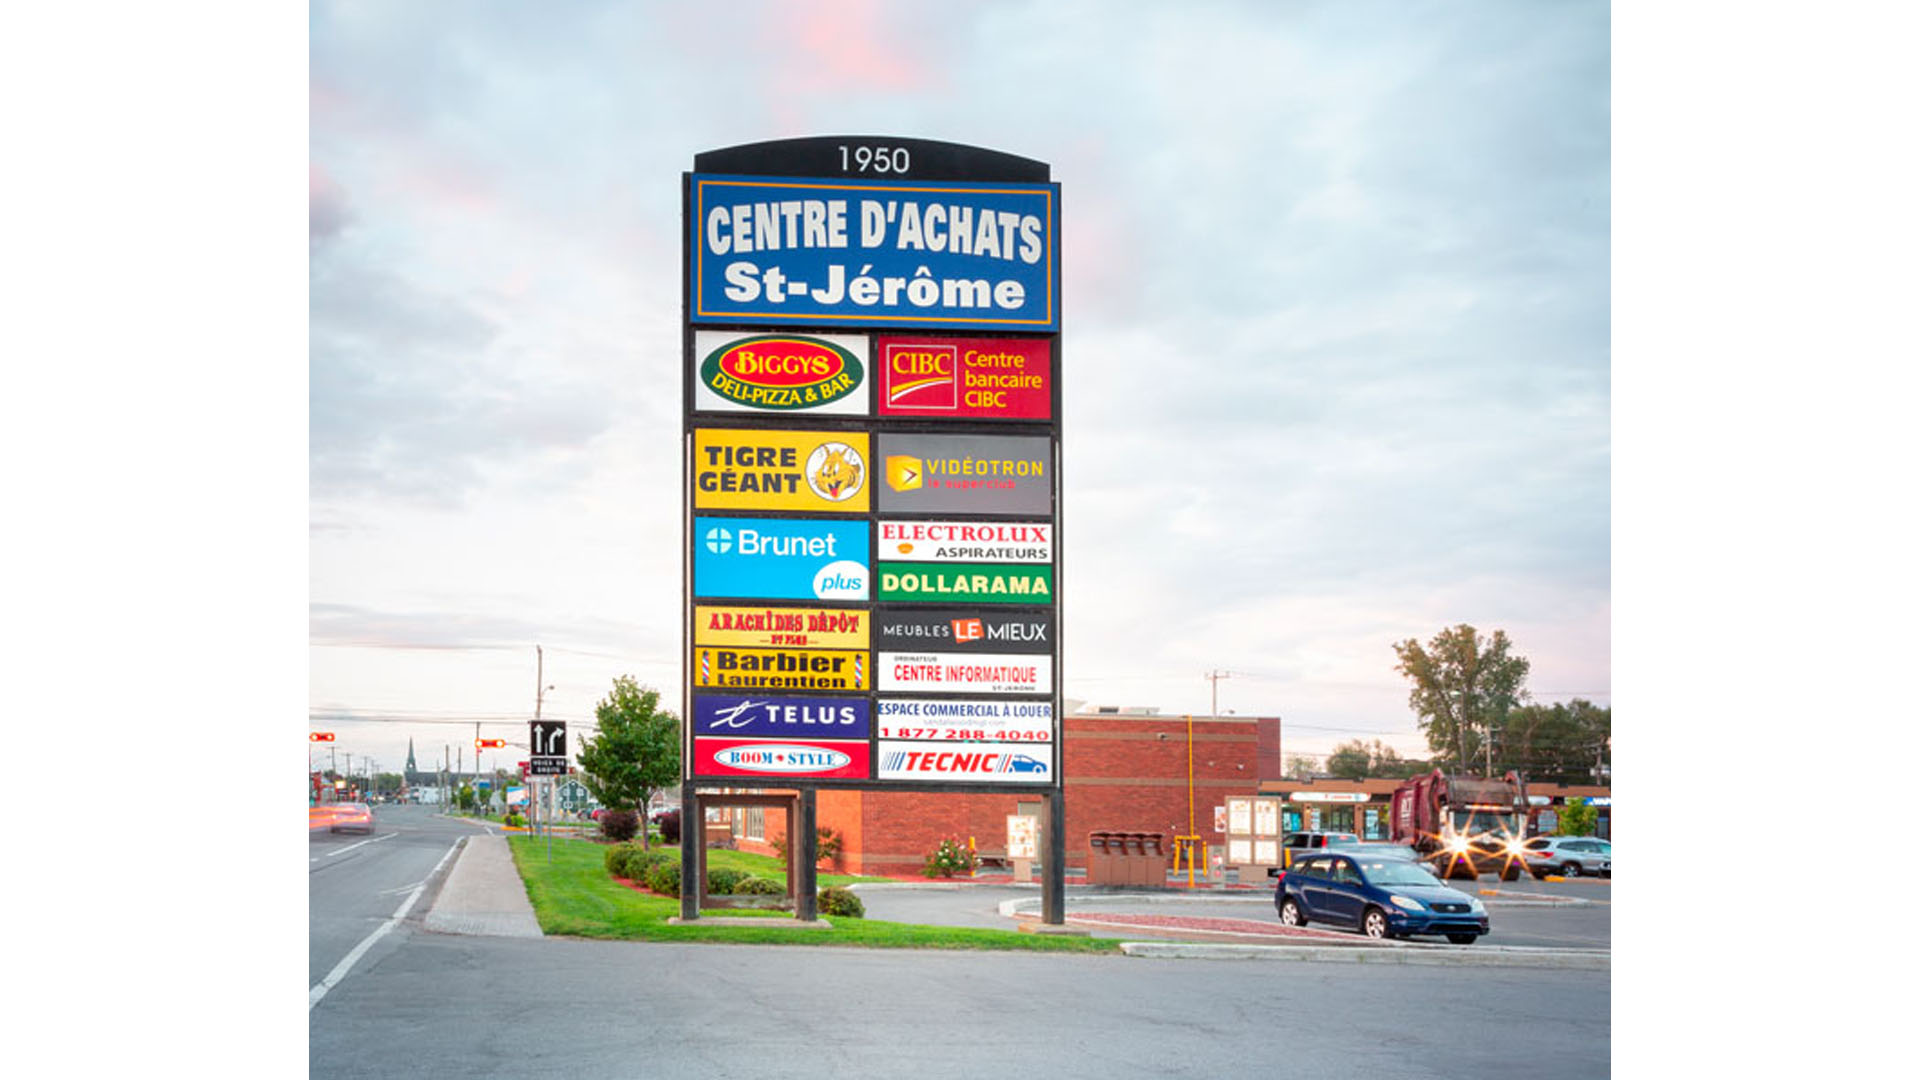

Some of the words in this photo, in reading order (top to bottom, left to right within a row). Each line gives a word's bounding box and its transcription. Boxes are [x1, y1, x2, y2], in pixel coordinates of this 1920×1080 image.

[839, 146, 910, 173] 1950
[707, 200, 848, 256] CENTRE
[861, 200, 1042, 265] D'ACHATS
[724, 262, 1025, 309] St-Jérôme
[734, 351, 830, 375] BIGGYS
[892, 352, 951, 375] CIBC
[964, 350, 1025, 368] Centre
[711, 372, 802, 406] DELI-PIZZA
[805, 387, 818, 402] &
[819, 373, 855, 400] BAR
[964, 370, 1043, 388] bancaire
[964, 391, 1007, 408] CIBC
[704, 446, 797, 467] TIGRE
[926, 456, 1044, 477] VIDÉOTRON
[699, 468, 801, 493] GÉANT
[928, 478, 940, 489] le
[945, 478, 1016, 491] superclub
[738, 529, 837, 557] Brunet
[882, 524, 1047, 543] ELECTROLUX
[935, 547, 1048, 559] ASPIRATEURS
[821, 573, 862, 592] plus
[882, 573, 1049, 594] DOLLARAMA
[883, 625, 949, 637] MEUBLES
[955, 621, 980, 640] LE
[987, 623, 1047, 641] MIEUX
[717, 651, 846, 673] Barbier
[717, 673, 846, 688] Laurentien
[894, 664, 943, 681] CENTRE
[945, 665, 1037, 683] INFORMATIQUE
[765, 705, 856, 724] TELUS
[878, 703, 920, 715] ESPACE
[923, 704, 999, 717] COMMERCIAL
[1002, 702, 1011, 717] À
[1014, 705, 1051, 717] LOUER
[881, 727, 889, 737] 1
[898, 728, 938, 739] 877
[945, 728, 1049, 741] 288-4040
[730, 752, 773, 764] BOOM
[787, 753, 836, 766] STYLE
[906, 752, 999, 772] TECNIC
